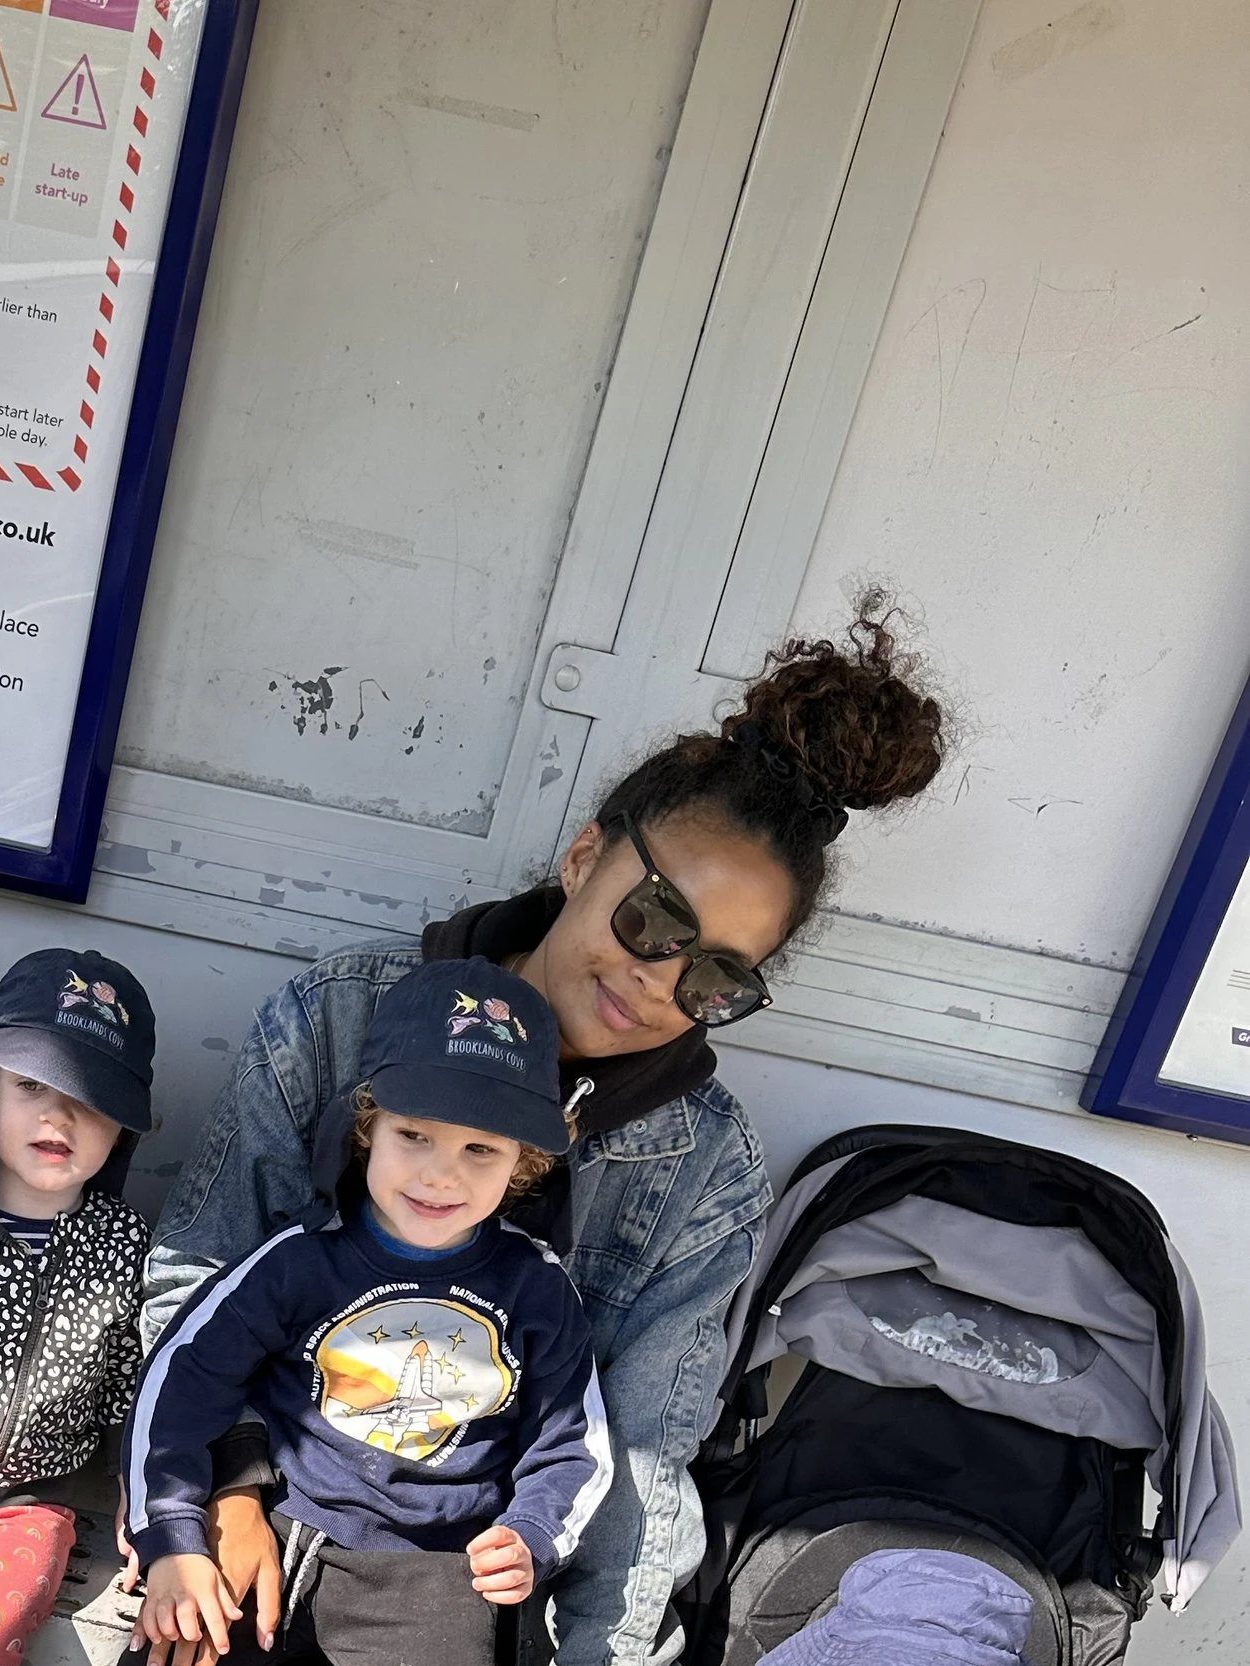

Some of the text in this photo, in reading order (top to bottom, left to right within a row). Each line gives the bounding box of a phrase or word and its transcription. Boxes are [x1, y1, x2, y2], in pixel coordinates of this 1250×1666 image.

[51, 164, 80, 181] Late
[35, 184, 88, 206] start-up
[27, 305, 57, 323] than
[33, 409, 64, 428] later
[21, 429, 47, 448] day.
[57, 1011, 125, 1049] BROOKLANDS COVE
[448, 1040, 524, 1070] BROOKLANDS COVE
[331, 1282, 420, 1322] ADMINISTRATION
[450, 1285, 494, 1312] NATIONAL
[306, 1321, 332, 1350] SPACE
